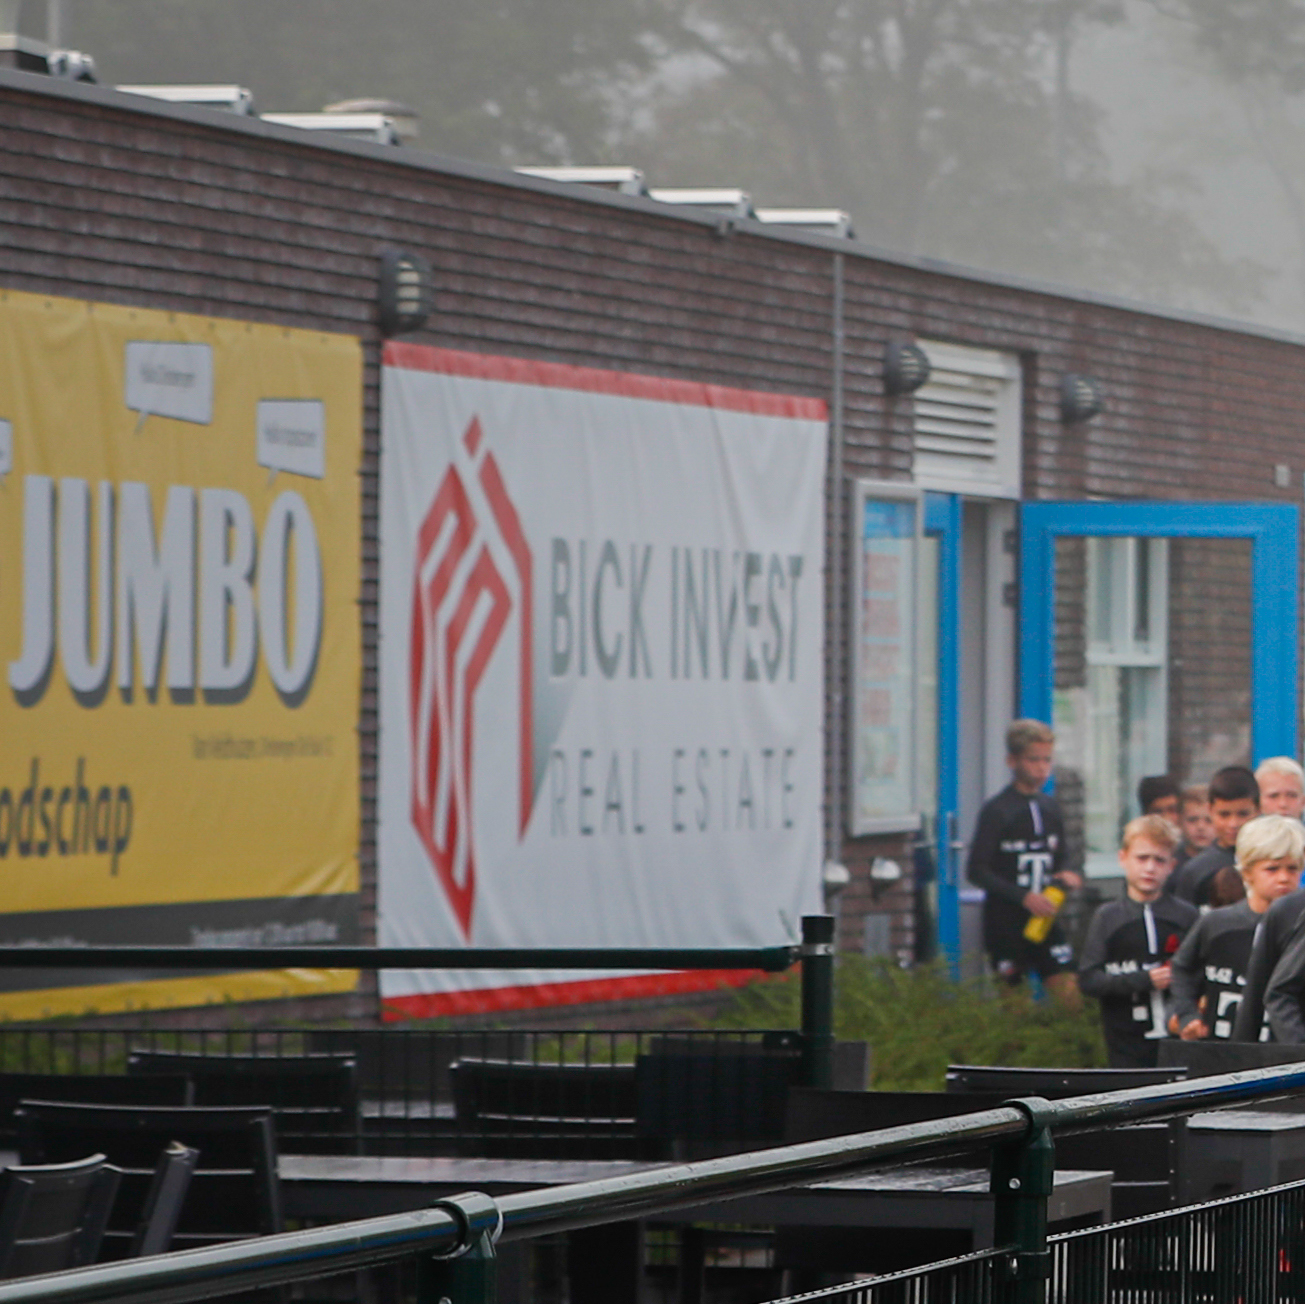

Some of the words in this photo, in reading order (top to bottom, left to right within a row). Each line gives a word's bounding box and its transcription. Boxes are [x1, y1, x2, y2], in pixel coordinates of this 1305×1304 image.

[8, 474, 326, 710] JUMBO
[552, 537, 652, 680] BICK
[671, 546, 804, 683] INVEST
[550, 749, 646, 838] REAL
[673, 748, 794, 832] ESTATE
